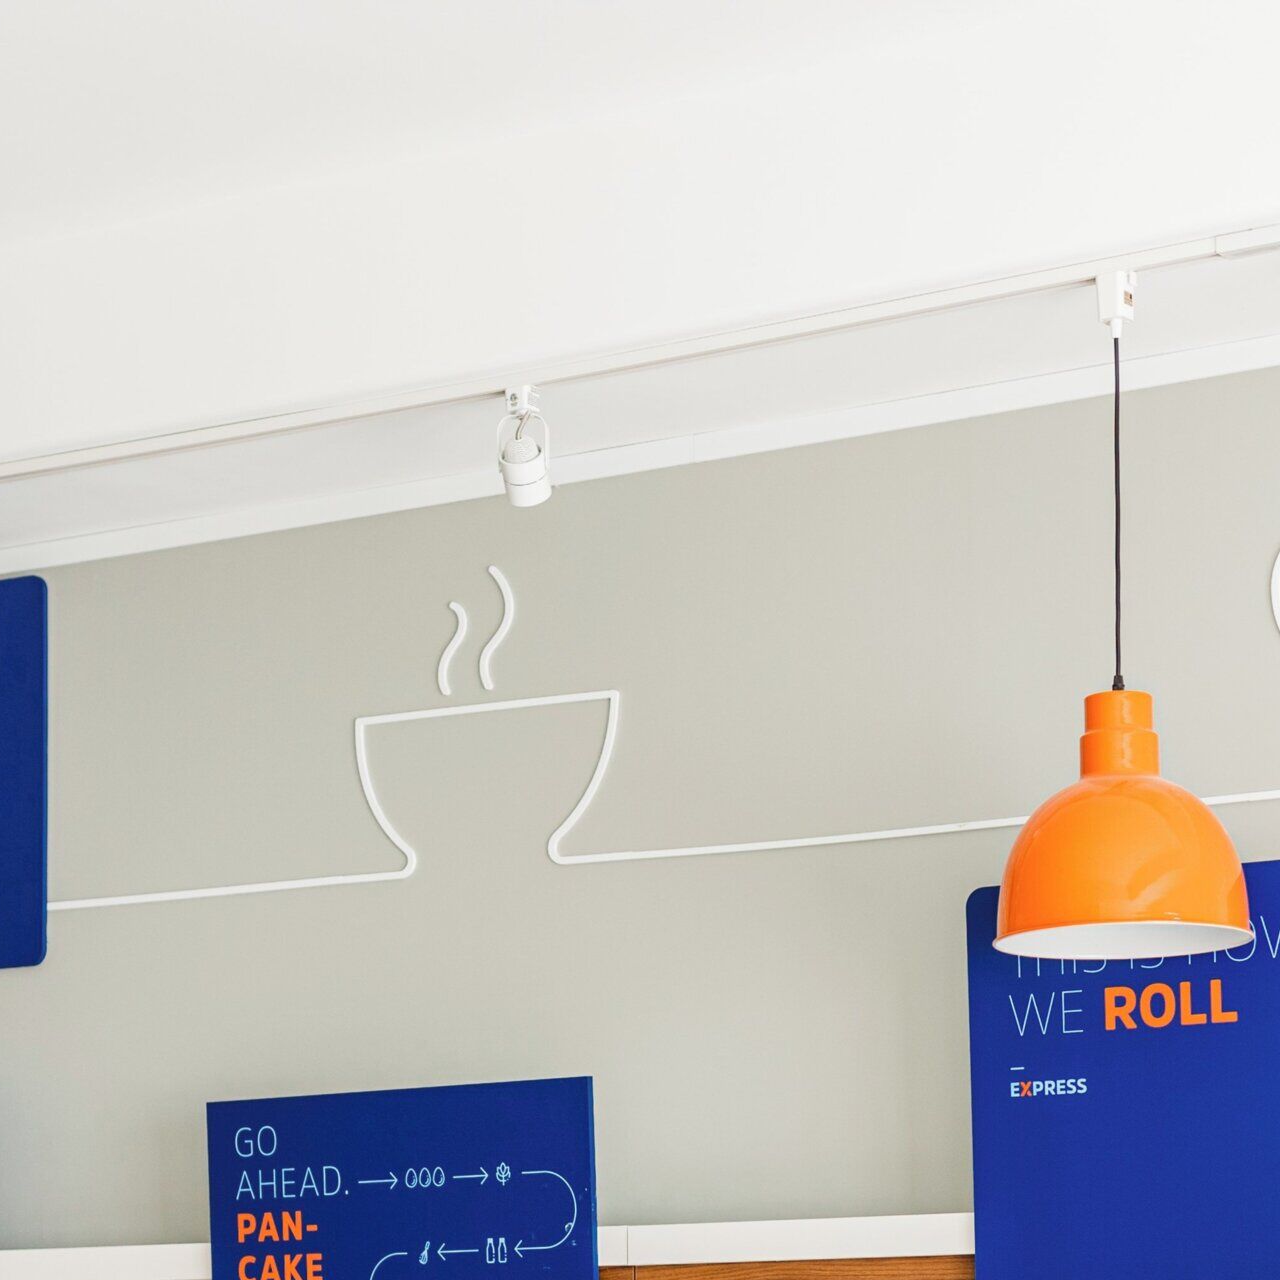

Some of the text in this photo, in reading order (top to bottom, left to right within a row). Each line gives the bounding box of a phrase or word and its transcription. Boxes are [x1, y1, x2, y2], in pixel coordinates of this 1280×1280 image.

[1008, 979, 1238, 1037] WE ROLL
[1010, 1078, 1088, 1098] EXPRESS
[234, 1125, 277, 1158] GO
[236, 1166, 349, 1200] AHEAD.
[237, 1210, 318, 1243] PAN-
